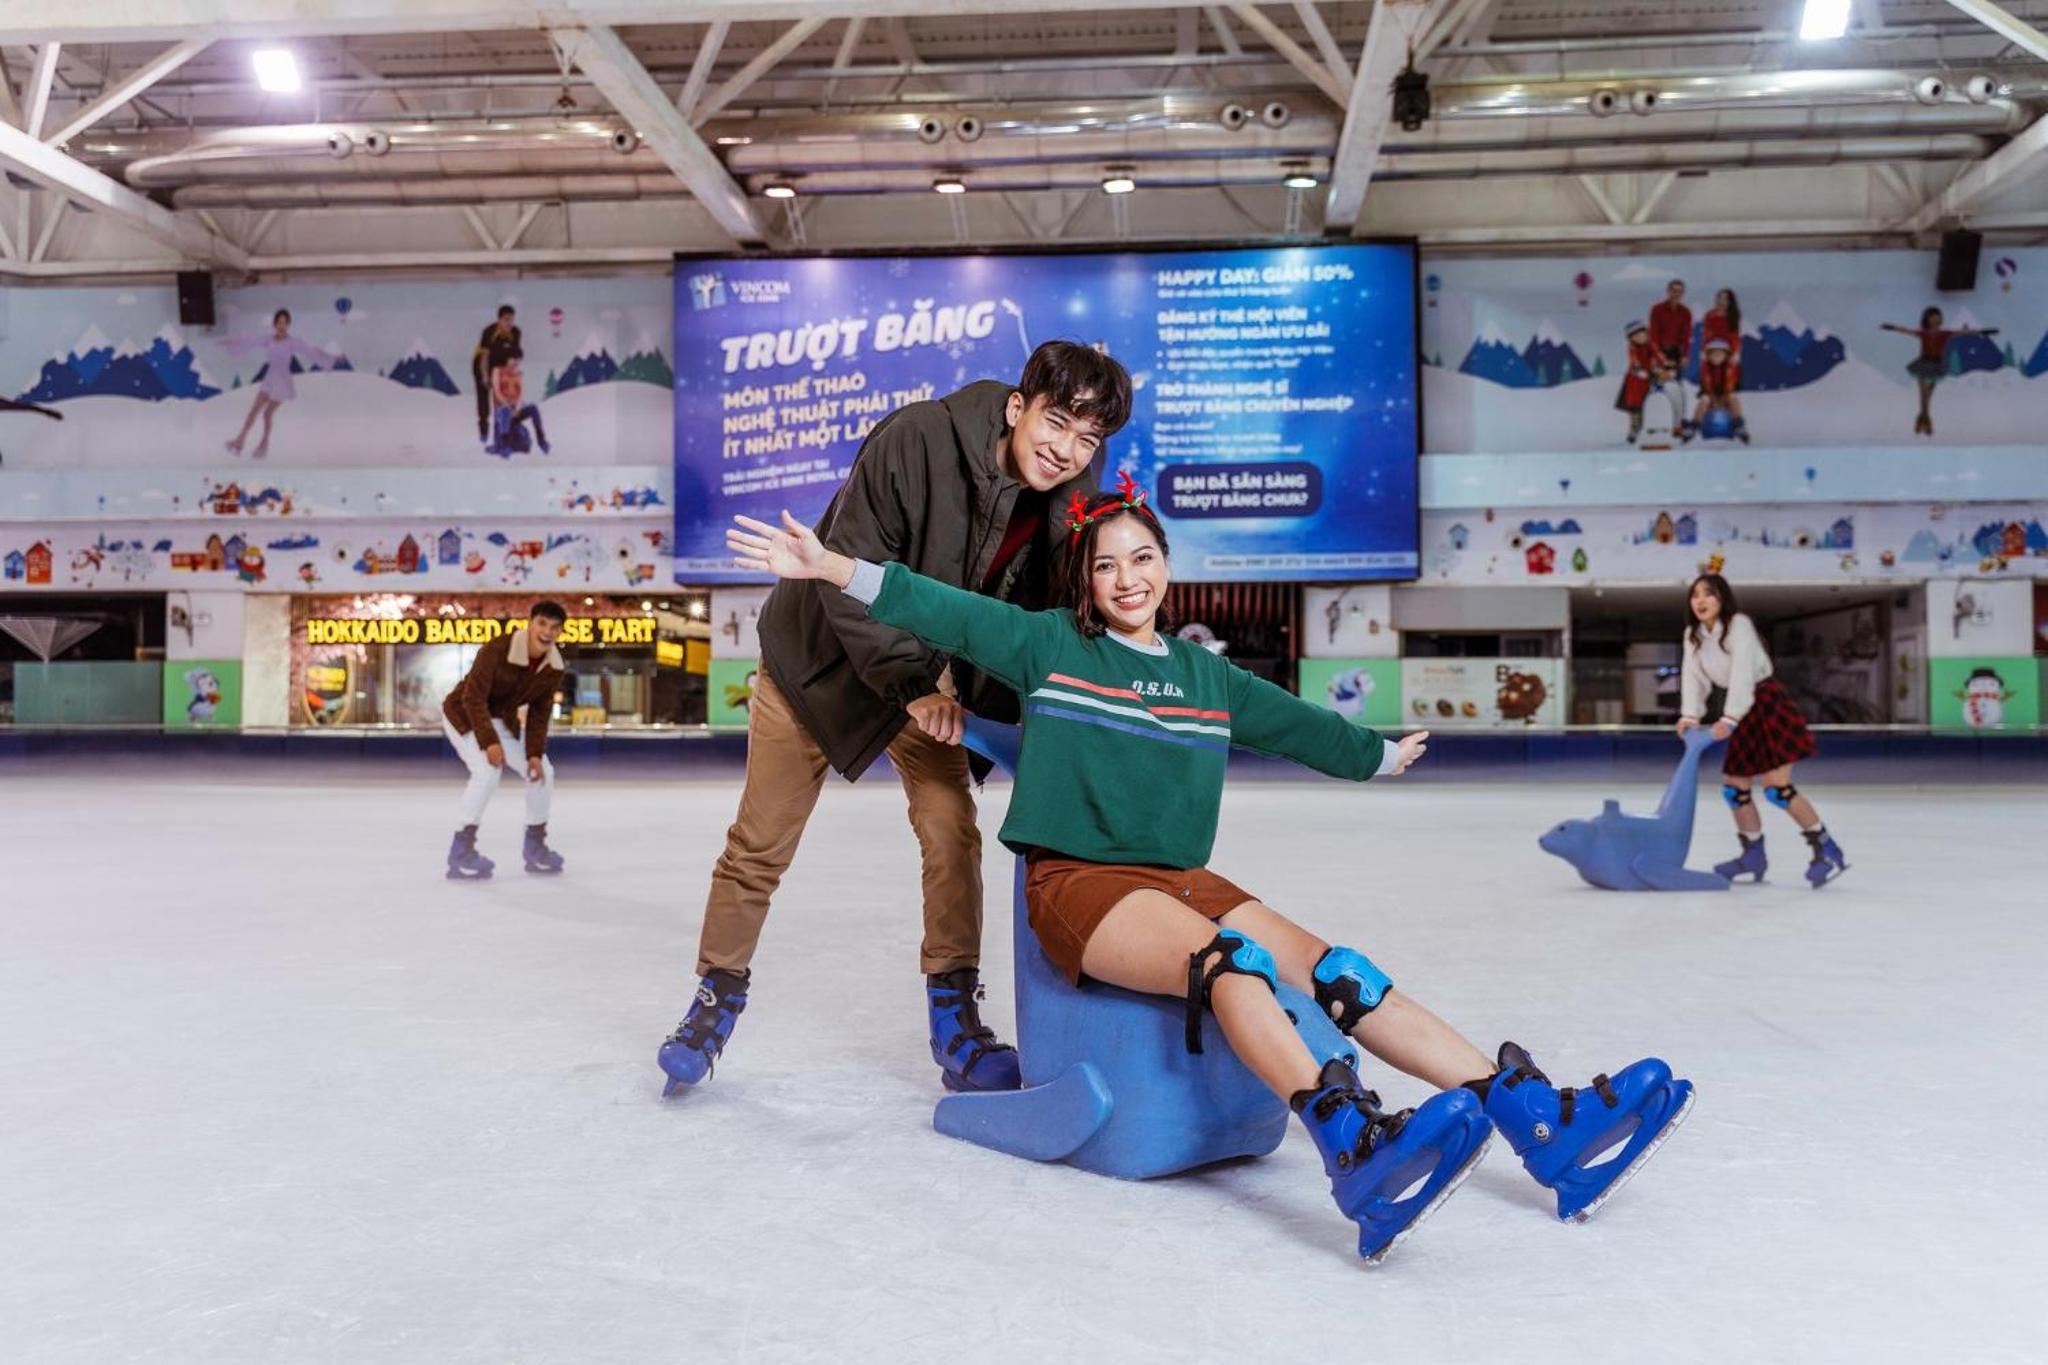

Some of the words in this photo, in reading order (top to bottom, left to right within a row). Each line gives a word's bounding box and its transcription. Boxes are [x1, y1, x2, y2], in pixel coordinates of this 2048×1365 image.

[1158, 269, 1217, 286] HAPPY
[1312, 264, 1354, 281] 50%
[720, 317, 868, 374] TRƯỢT
[873, 297, 996, 352] BĂNG
[723, 383, 769, 410] MÔN
[813, 372, 866, 396] THAO
[723, 406, 776, 435] NGHỆ
[743, 429, 796, 455] NHẤT
[799, 419, 841, 449] MỘT
[307, 618, 420, 643] HOKKAIDO
[425, 618, 502, 643] BAKED
[598, 618, 656, 643] TART
